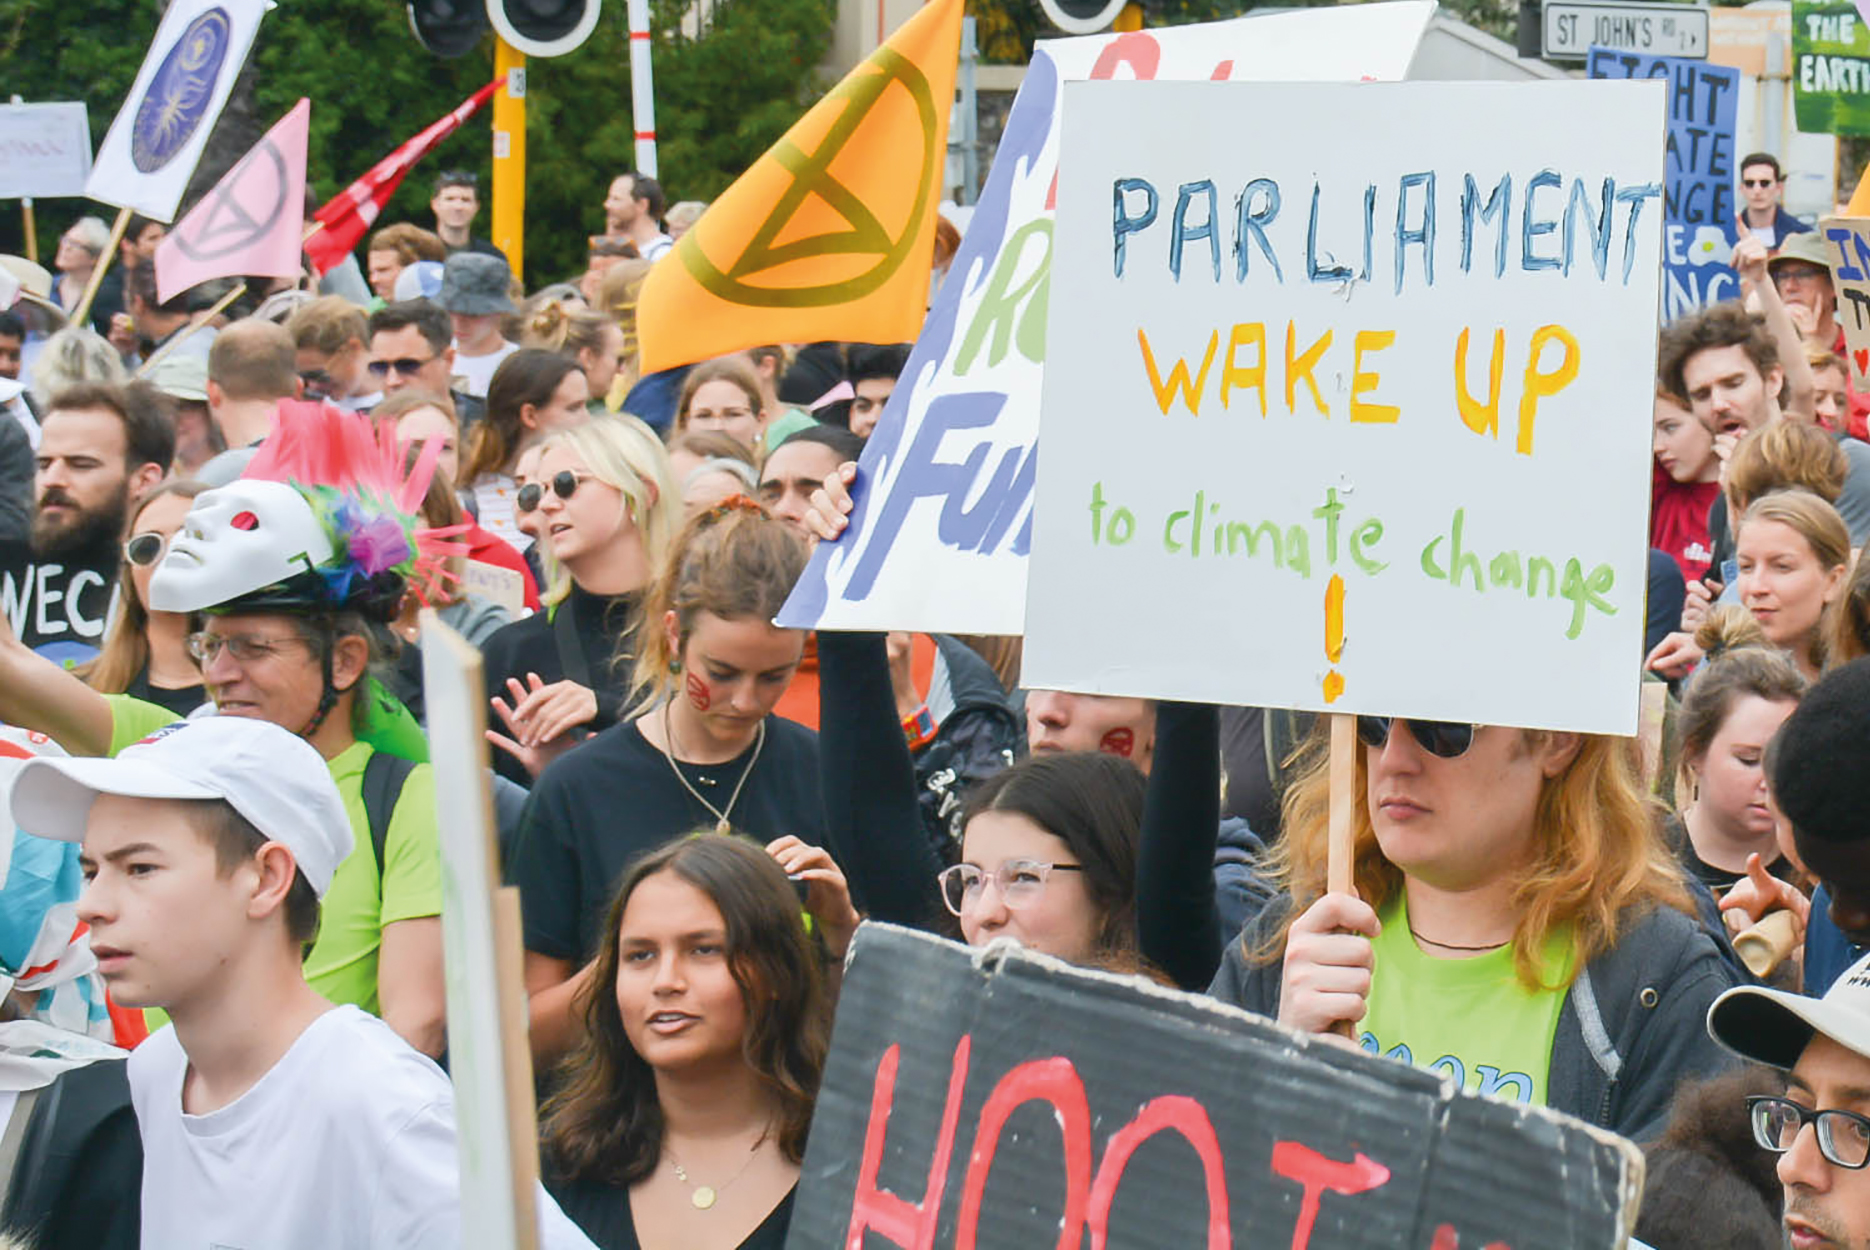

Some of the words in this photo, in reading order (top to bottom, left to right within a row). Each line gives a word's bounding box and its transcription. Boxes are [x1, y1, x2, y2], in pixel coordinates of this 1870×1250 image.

[1557, 13, 1579, 46] ST
[1591, 15, 1653, 48] JOHN'S
[1806, 13, 1856, 45] THE
[1113, 168, 1662, 296] PARLIAMENT
[1137, 319, 1401, 423] WAKE
[1455, 324, 1581, 456] UP
[1089, 481, 1136, 546] to
[1163, 487, 1390, 579] climate
[1420, 507, 1619, 641] change
